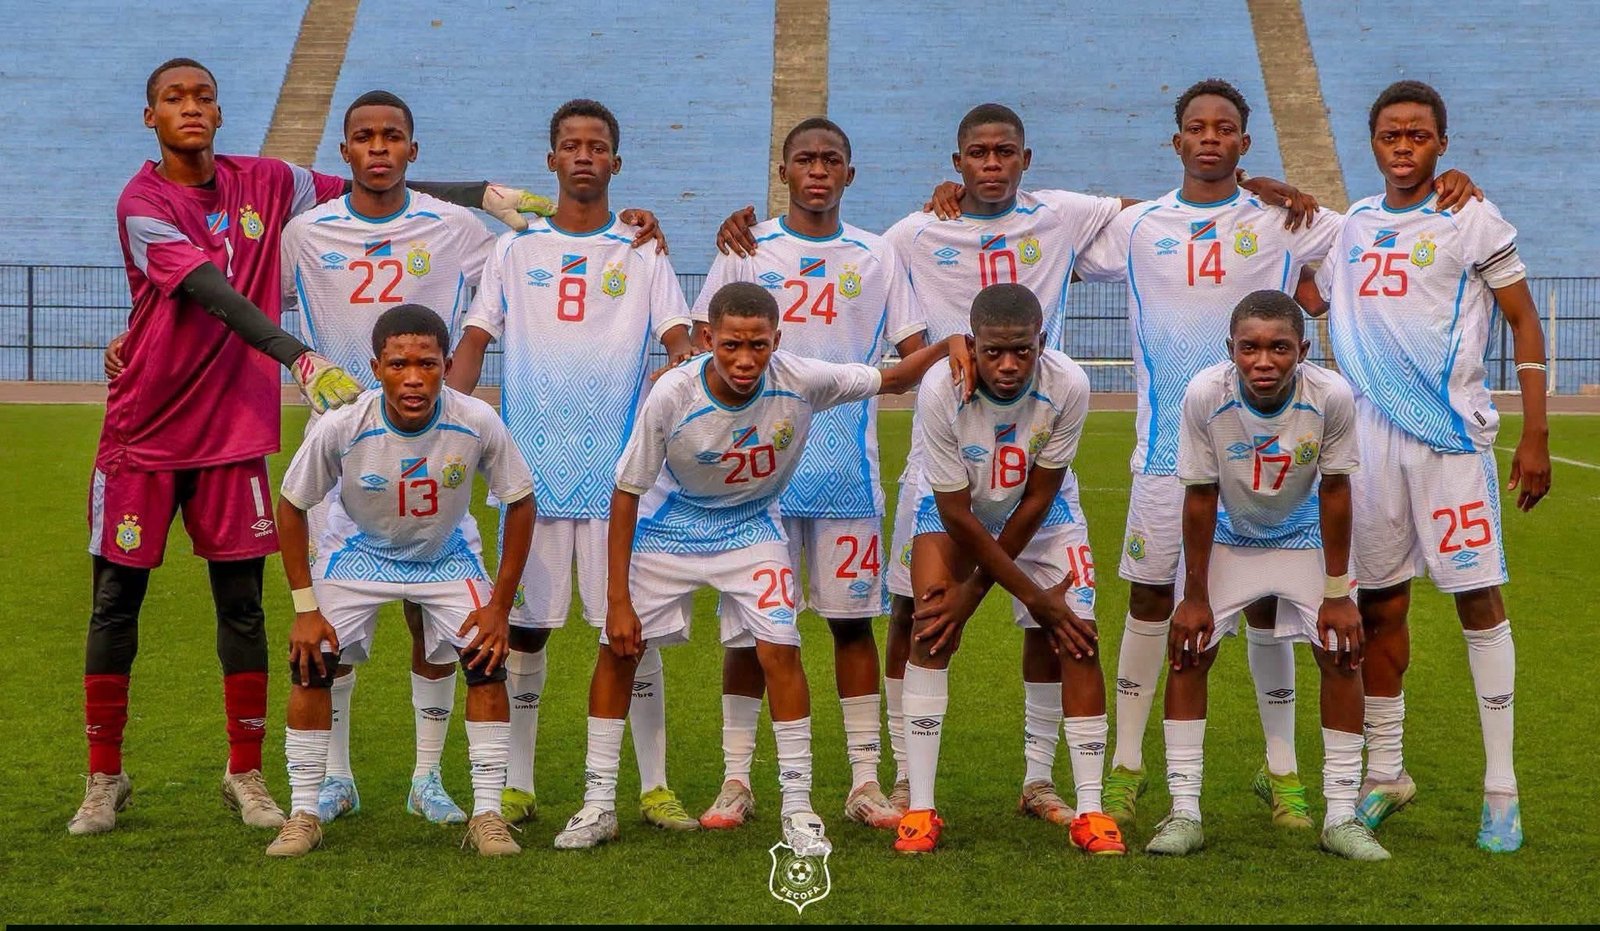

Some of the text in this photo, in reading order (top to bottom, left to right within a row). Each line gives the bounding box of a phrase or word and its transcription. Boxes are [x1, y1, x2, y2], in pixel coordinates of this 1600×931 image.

[348, 260, 403, 304] 22
[979, 250, 1017, 290] 10
[1188, 242, 1226, 286] 14
[1359, 253, 1410, 297] 25
[557, 277, 586, 322] 8
[783, 280, 837, 324] 24
[722, 444, 776, 484] 20
[991, 446, 1026, 490] 18
[1253, 453, 1291, 491] 17
[250, 476, 265, 517] 1
[399, 479, 438, 517] 13
[1433, 501, 1491, 553] 25
[836, 534, 880, 578] 24
[1117, 689, 1139, 697] mbro
